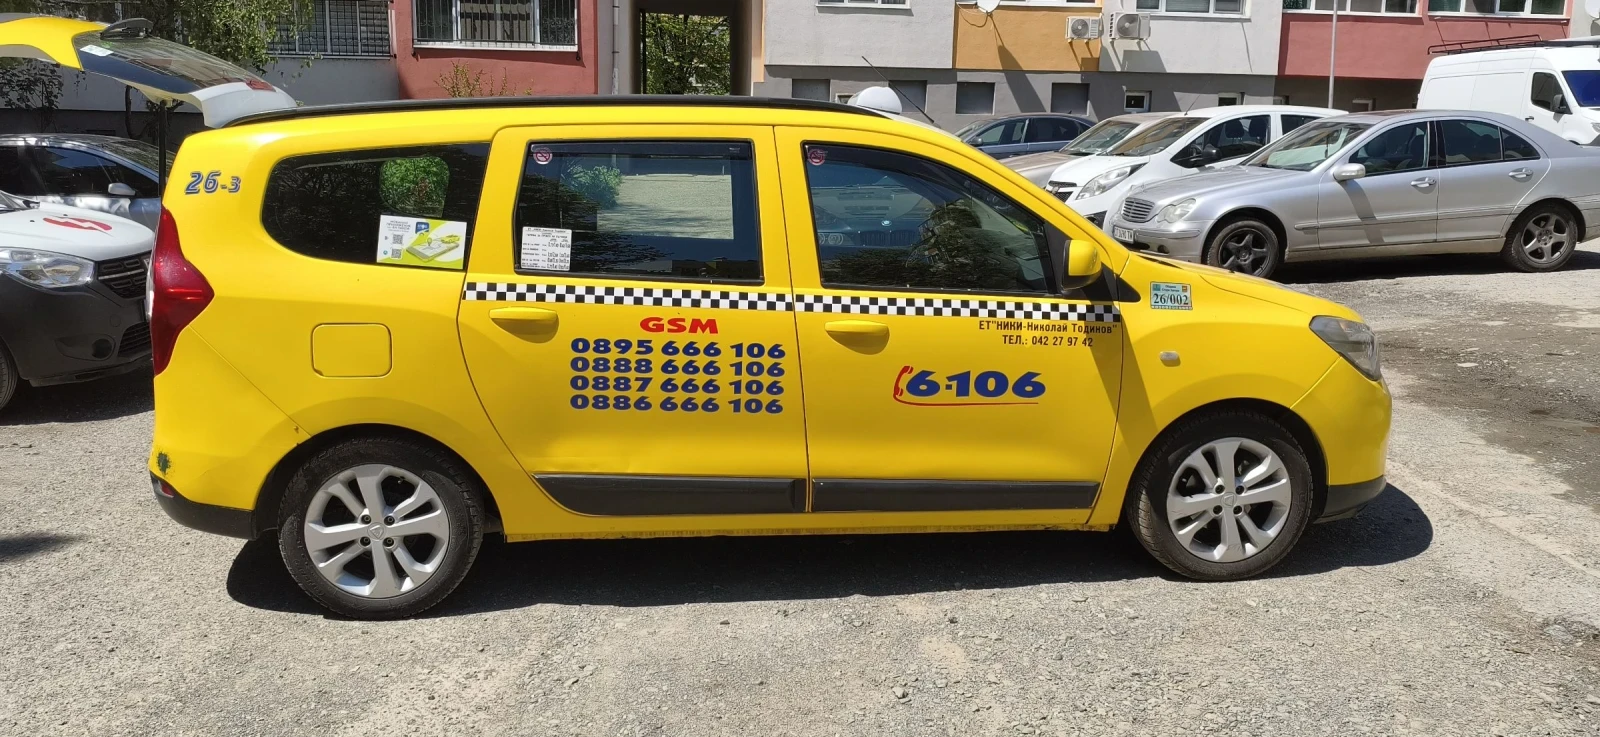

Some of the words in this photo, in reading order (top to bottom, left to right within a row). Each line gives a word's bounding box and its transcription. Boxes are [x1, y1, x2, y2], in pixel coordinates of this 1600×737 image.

[184, 170, 241, 195] 26-3
[1153, 293, 1189, 305] 26/002
[640, 316, 719, 334] GSM
[570, 337, 654, 355] 0895
[661, 340, 722, 357] 666
[729, 342, 786, 359] 106
[1002, 334, 1028, 345] ТЕЛ.:
[1031, 335, 1049, 346] 042
[1052, 336, 1063, 346] 27
[1067, 337, 1078, 347] 97
[1081, 337, 1093, 347] 42
[570, 356, 653, 374] 0888
[660, 359, 721, 376] 666
[729, 361, 785, 377] 106
[570, 375, 653, 392] 0887
[660, 377, 721, 394] 666
[728, 379, 785, 396] 106
[905, 369, 1046, 399] 6-106
[570, 394, 653, 411] 0886
[659, 396, 720, 412] 666
[728, 398, 784, 414] 106
